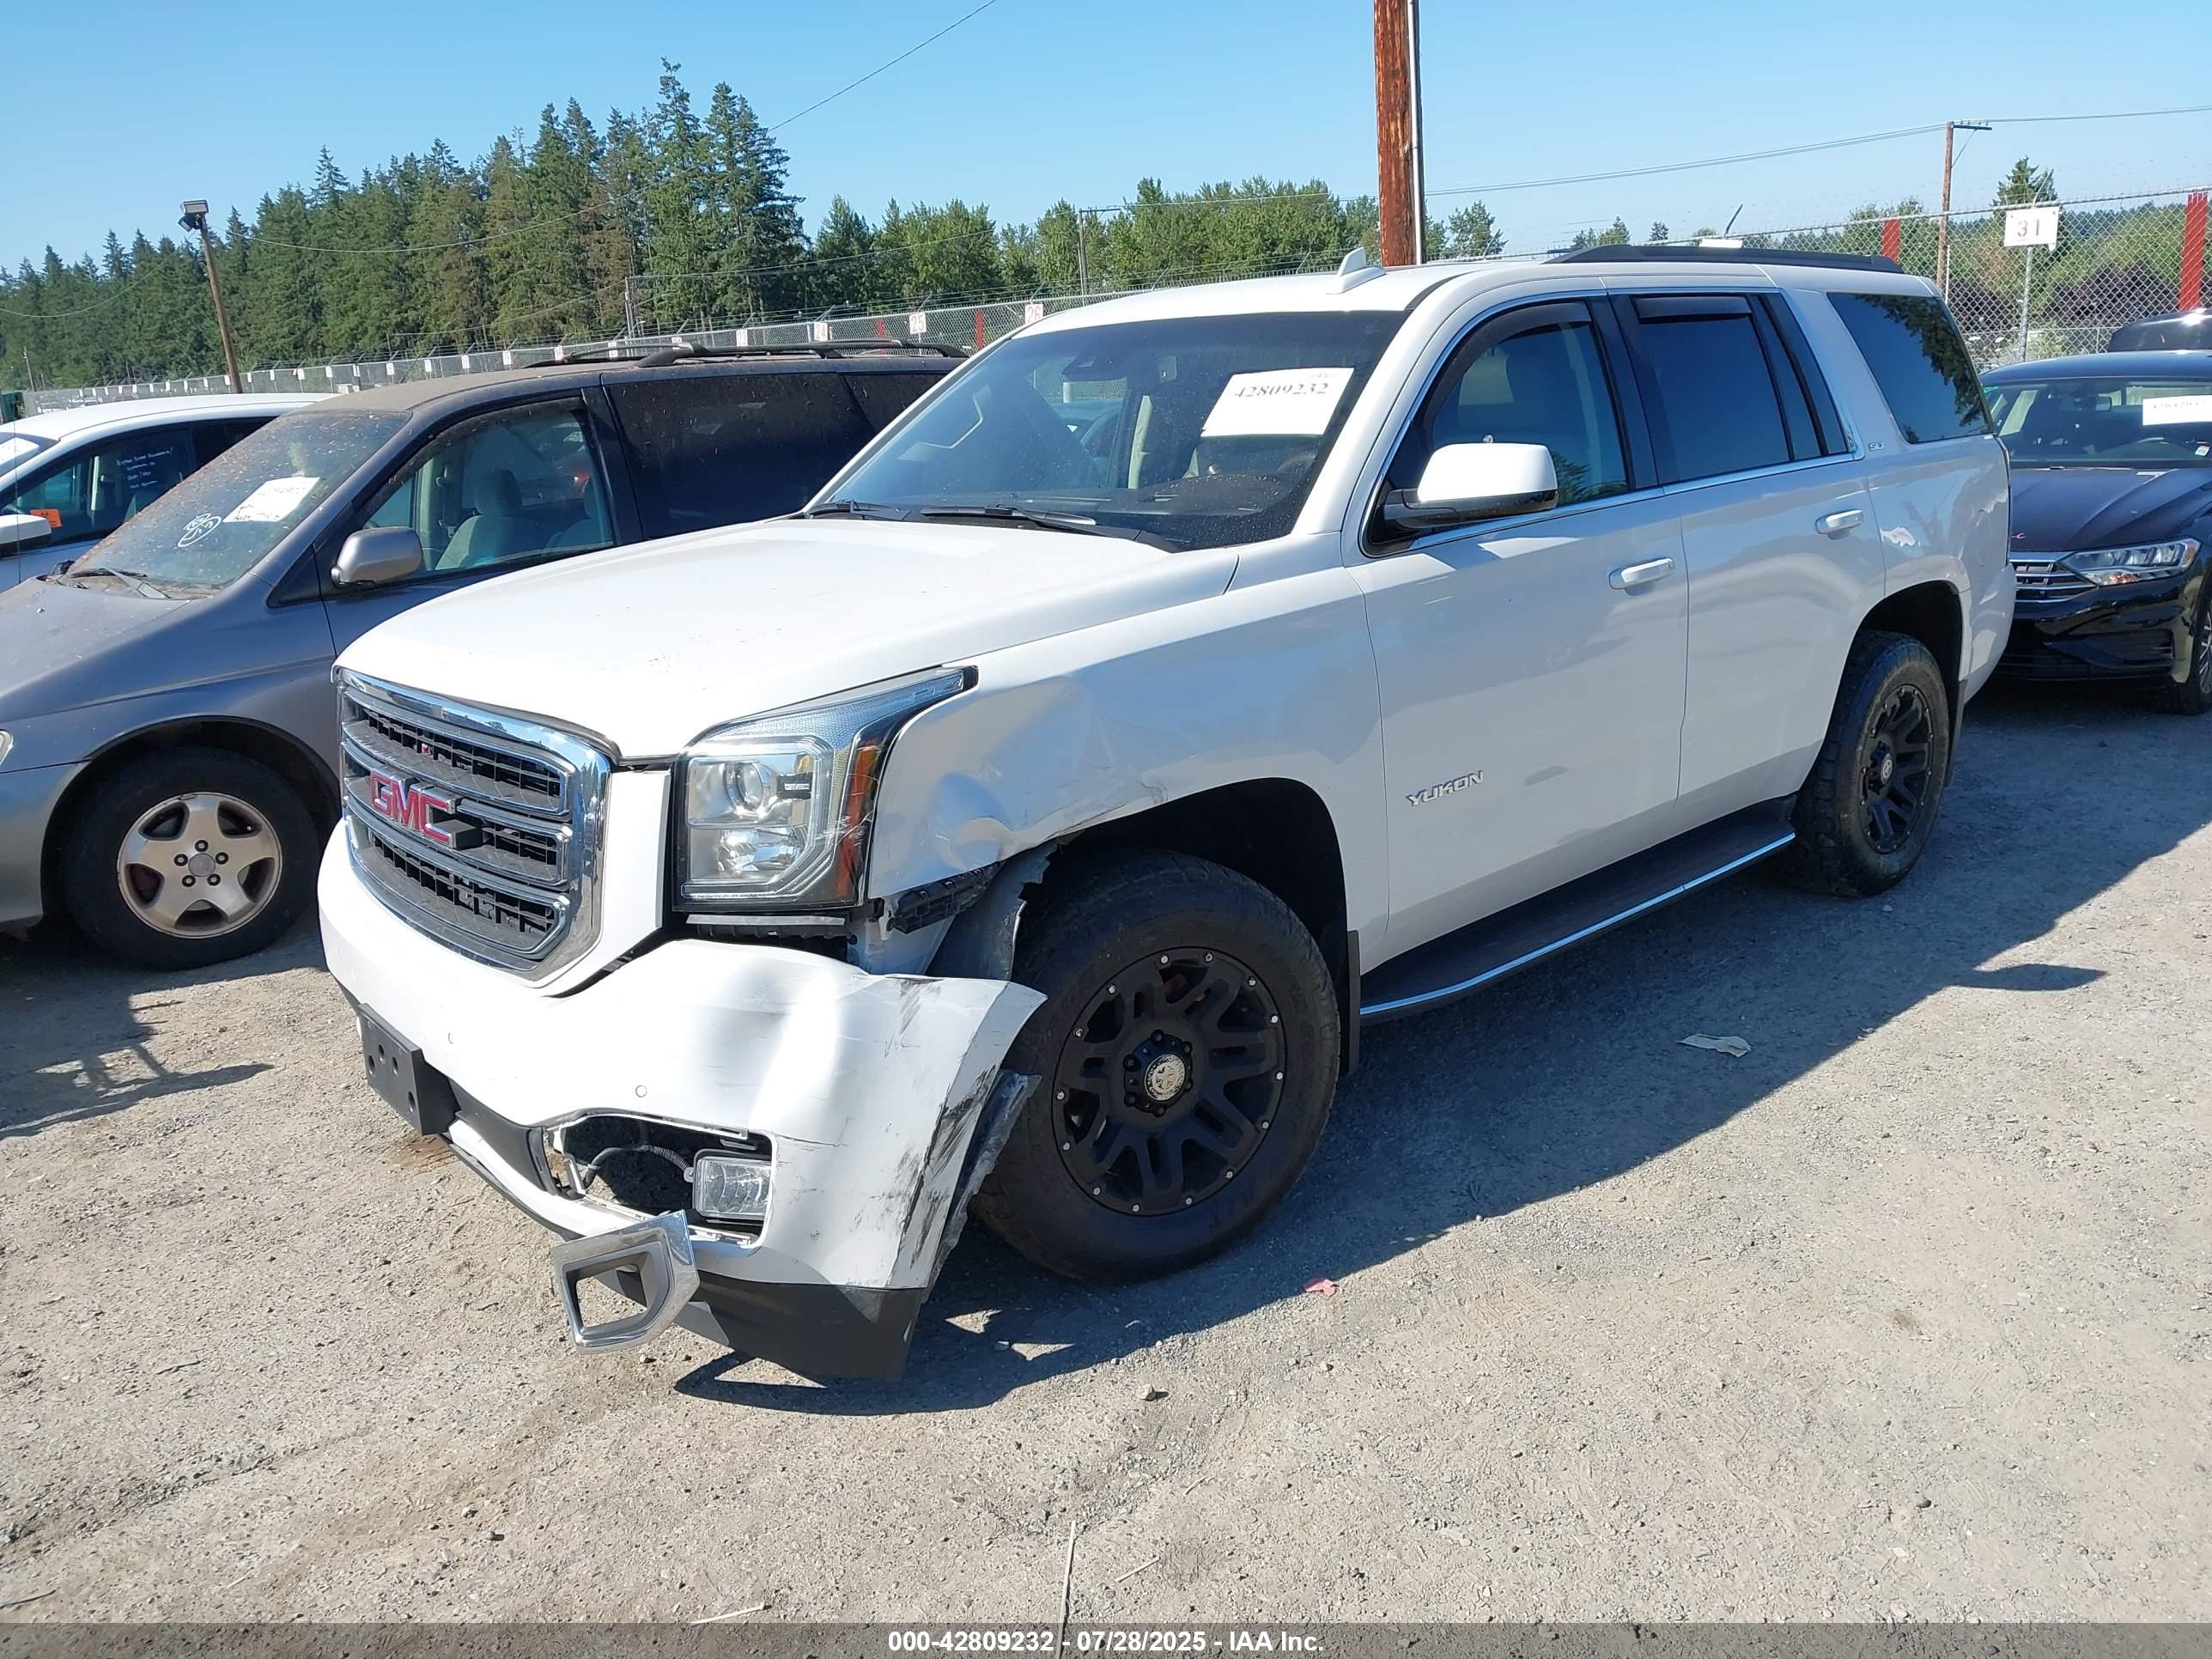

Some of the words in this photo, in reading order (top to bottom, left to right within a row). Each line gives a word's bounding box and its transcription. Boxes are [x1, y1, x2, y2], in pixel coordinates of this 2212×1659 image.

[2017, 218, 2040, 237] 31
[911, 315, 925, 332] 25
[1234, 382, 1329, 398] 42809232
[1406, 769, 1484, 806] YUKON
[370, 768, 457, 848] GMC
